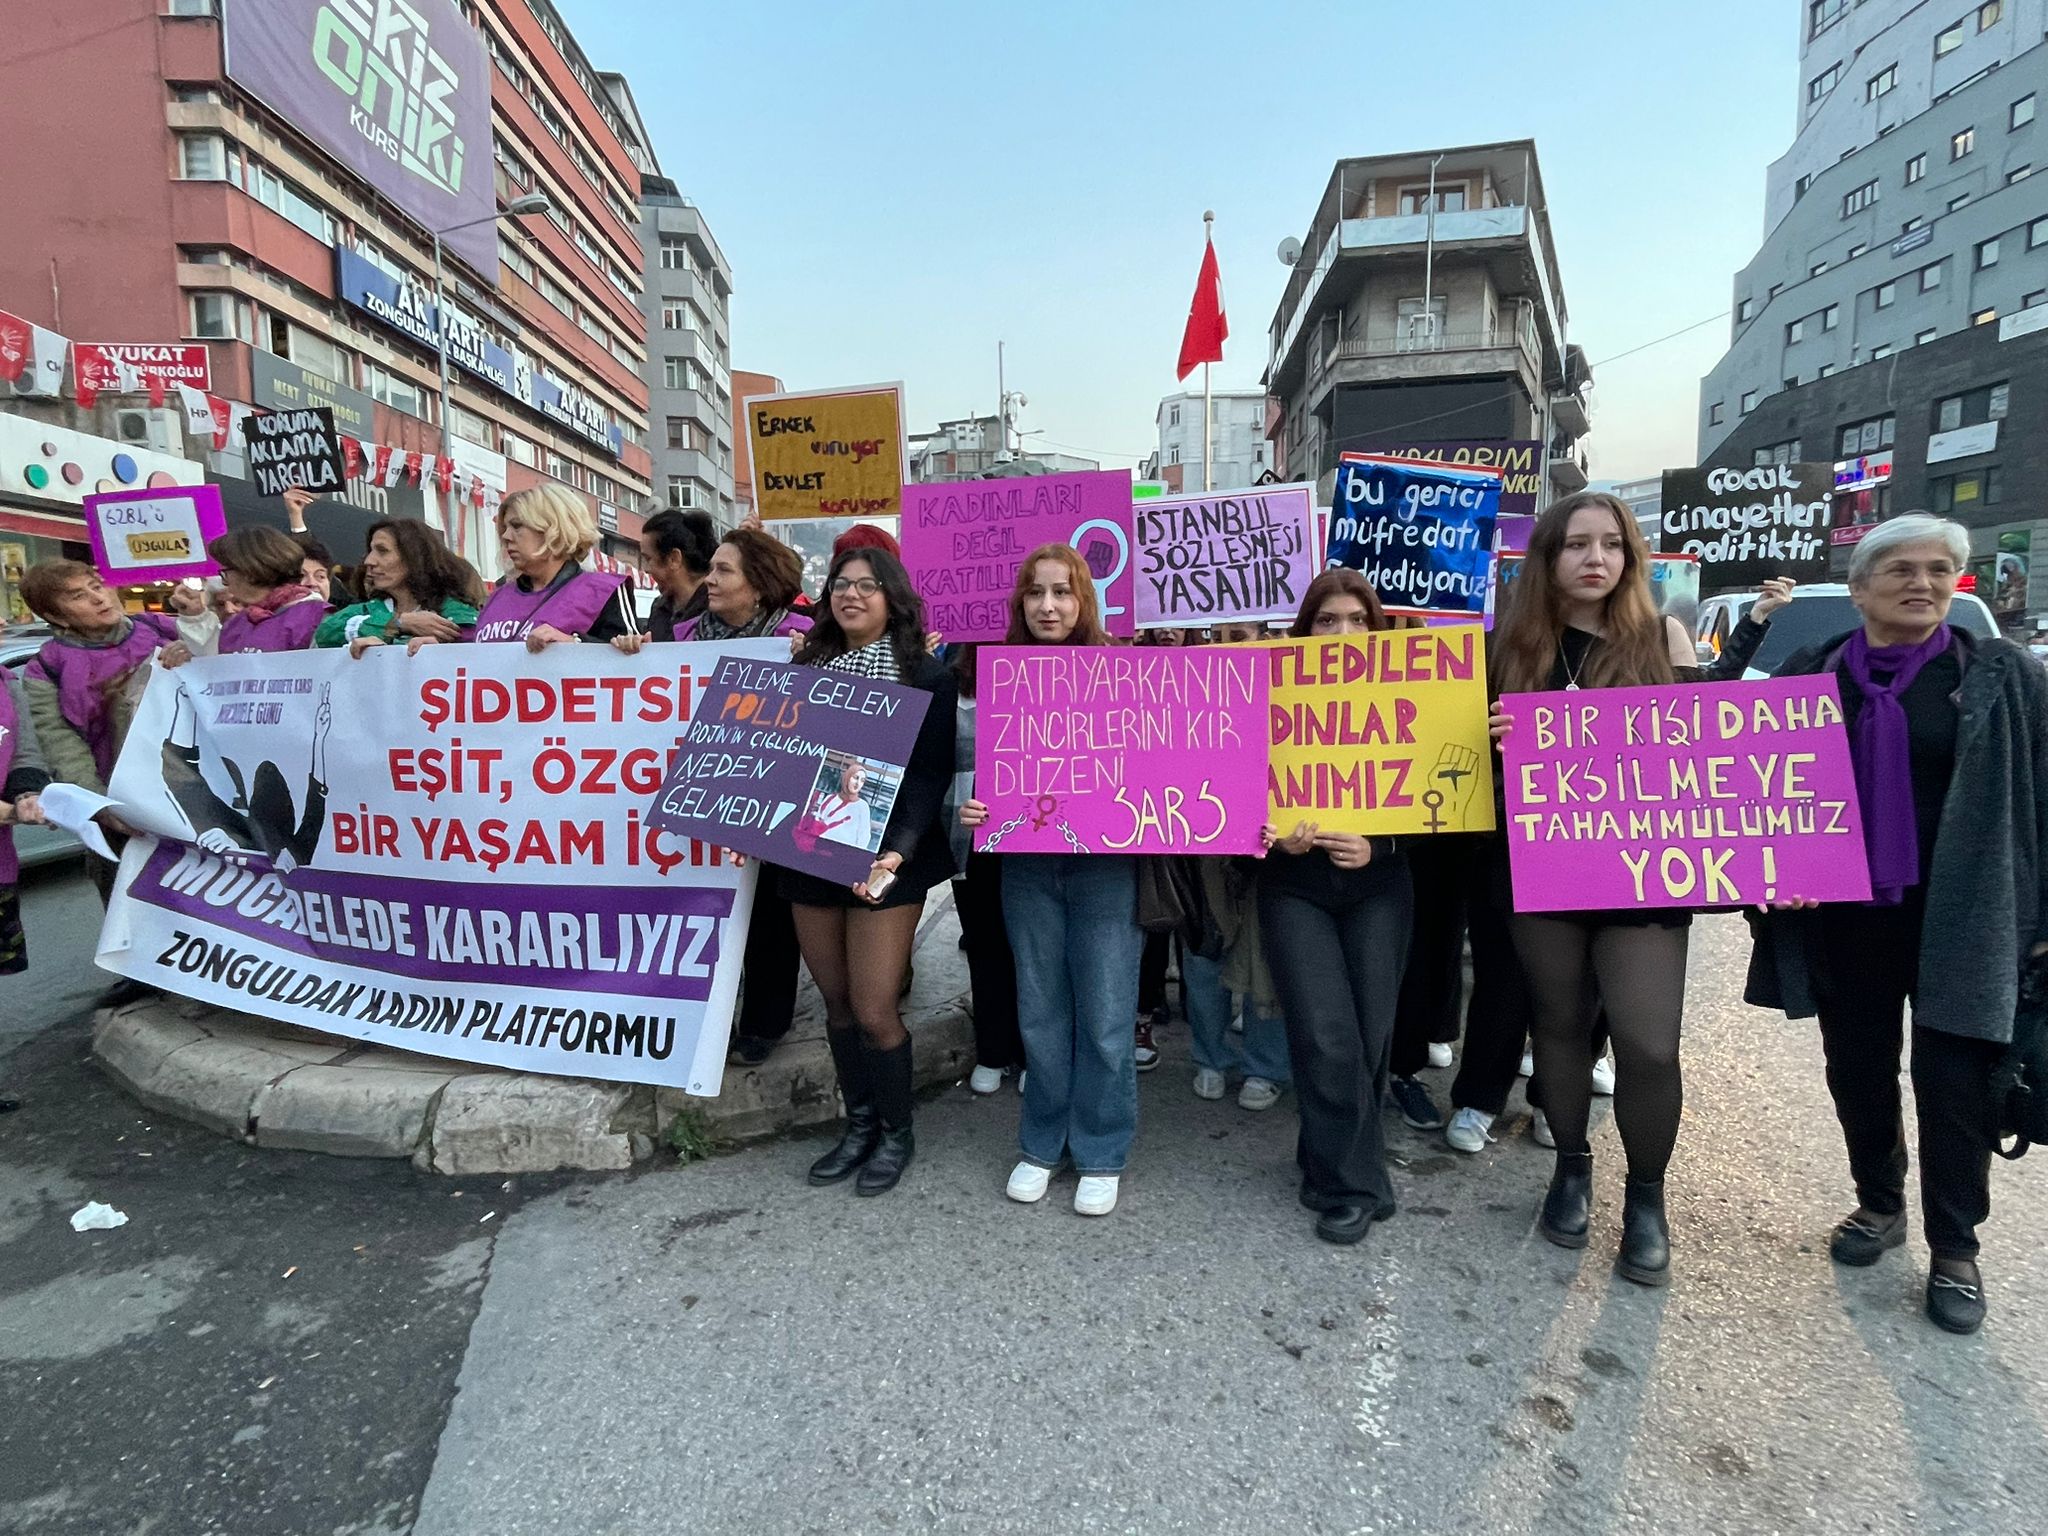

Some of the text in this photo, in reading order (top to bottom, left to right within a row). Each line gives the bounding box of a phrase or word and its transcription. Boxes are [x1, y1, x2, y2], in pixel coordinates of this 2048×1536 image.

[350, 104, 399, 161] KURS
[366, 291, 440, 348] ZONGULDAK
[398, 284, 428, 325] AK
[257, 410, 325, 436] KORUMA
[250, 432, 333, 464] AKLAMA
[256, 459, 338, 495] YARGILA
[1345, 467, 1488, 522] bu gerici
[1707, 463, 1801, 496] Çocuk
[918, 484, 1082, 528] KADINLARI
[1136, 497, 1283, 546] İSTANBUL
[1663, 492, 1832, 536] cinayetleri
[133, 537, 190, 555] UYGULA!
[1335, 516, 1480, 555] müfredatı
[1681, 528, 1825, 563] politiktir.
[719, 661, 901, 718] EYLEME GELEN
[991, 649, 1256, 707] PATRİYARKANIN
[990, 702, 1242, 752] ZİNCİRLERİNİ KIR
[1534, 694, 1844, 750] BİR KİŞİ DAHA
[388, 737, 684, 803] EŞİT, ÖZG
[674, 753, 776, 780] NEDEN
[994, 751, 1126, 797] DÜZENİ
[1519, 752, 1817, 805] EKSİLMEYE
[1100, 779, 1228, 849] SARS
[1513, 799, 1850, 842] TAHAMMÜLÜMÜZ
[332, 803, 402, 858] BİR
[411, 817, 605, 873] YAŞAM
[155, 930, 676, 1061] ZONGULDAK KADIN PLATFORMU
